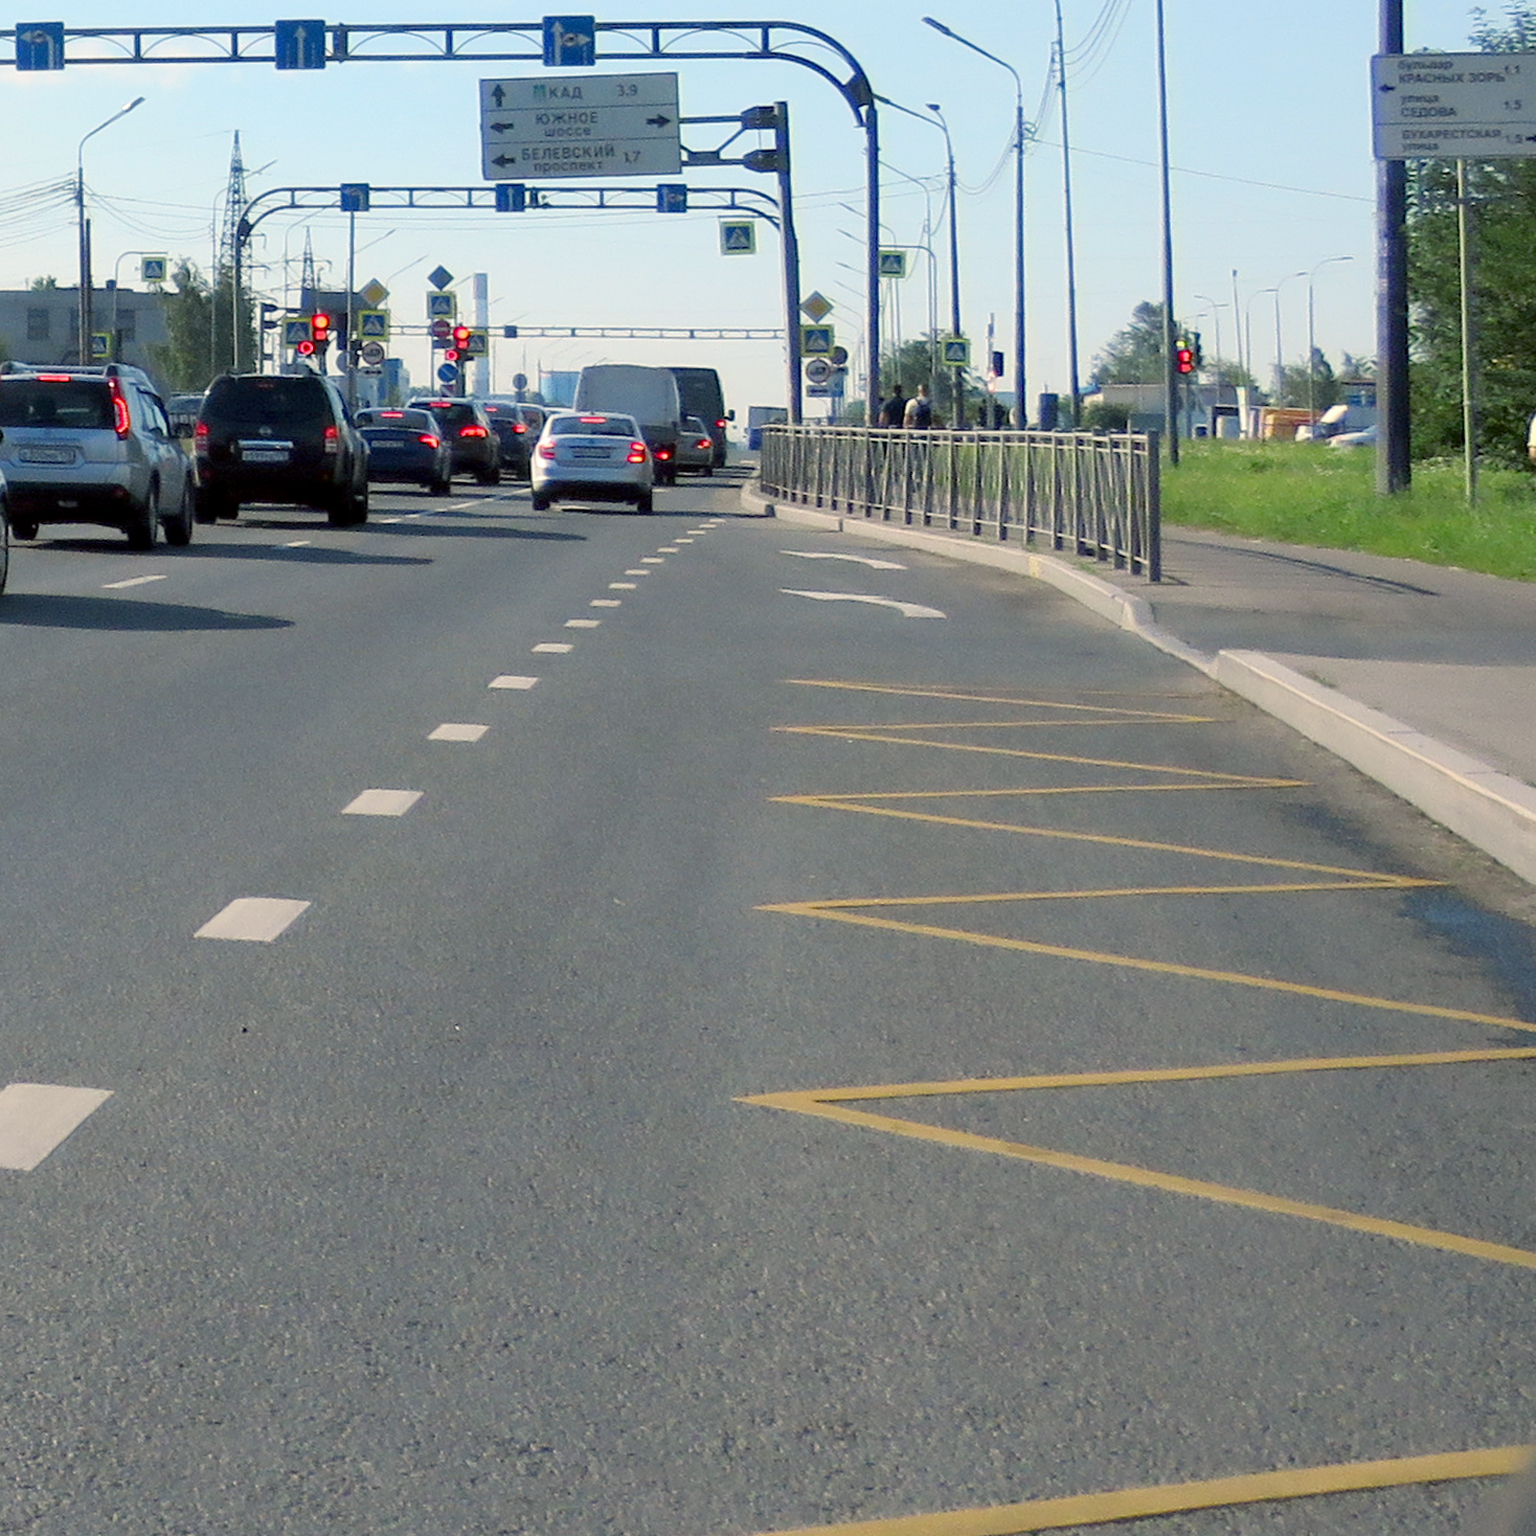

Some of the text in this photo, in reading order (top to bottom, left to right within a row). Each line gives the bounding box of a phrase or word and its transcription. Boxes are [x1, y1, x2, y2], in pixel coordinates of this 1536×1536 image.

[1398, 61, 1453, 71] бульвар
[1399, 72, 1505, 84] КРАСНЫХ ЗОРЬ
[549, 86, 583, 100] КАД
[1400, 95, 1439, 105] улица
[1401, 107, 1457, 118] СЕДОВА
[535, 112, 599, 126] ЮЖНОЕ
[544, 126, 591, 137] шоссе
[1402, 129, 1502, 140] БУХАРЕСТСКАЯ
[522, 143, 616, 161] БЕЛЕВСКИЙ
[1401, 142, 1439, 152] улица
[533, 161, 603, 174] проспект
